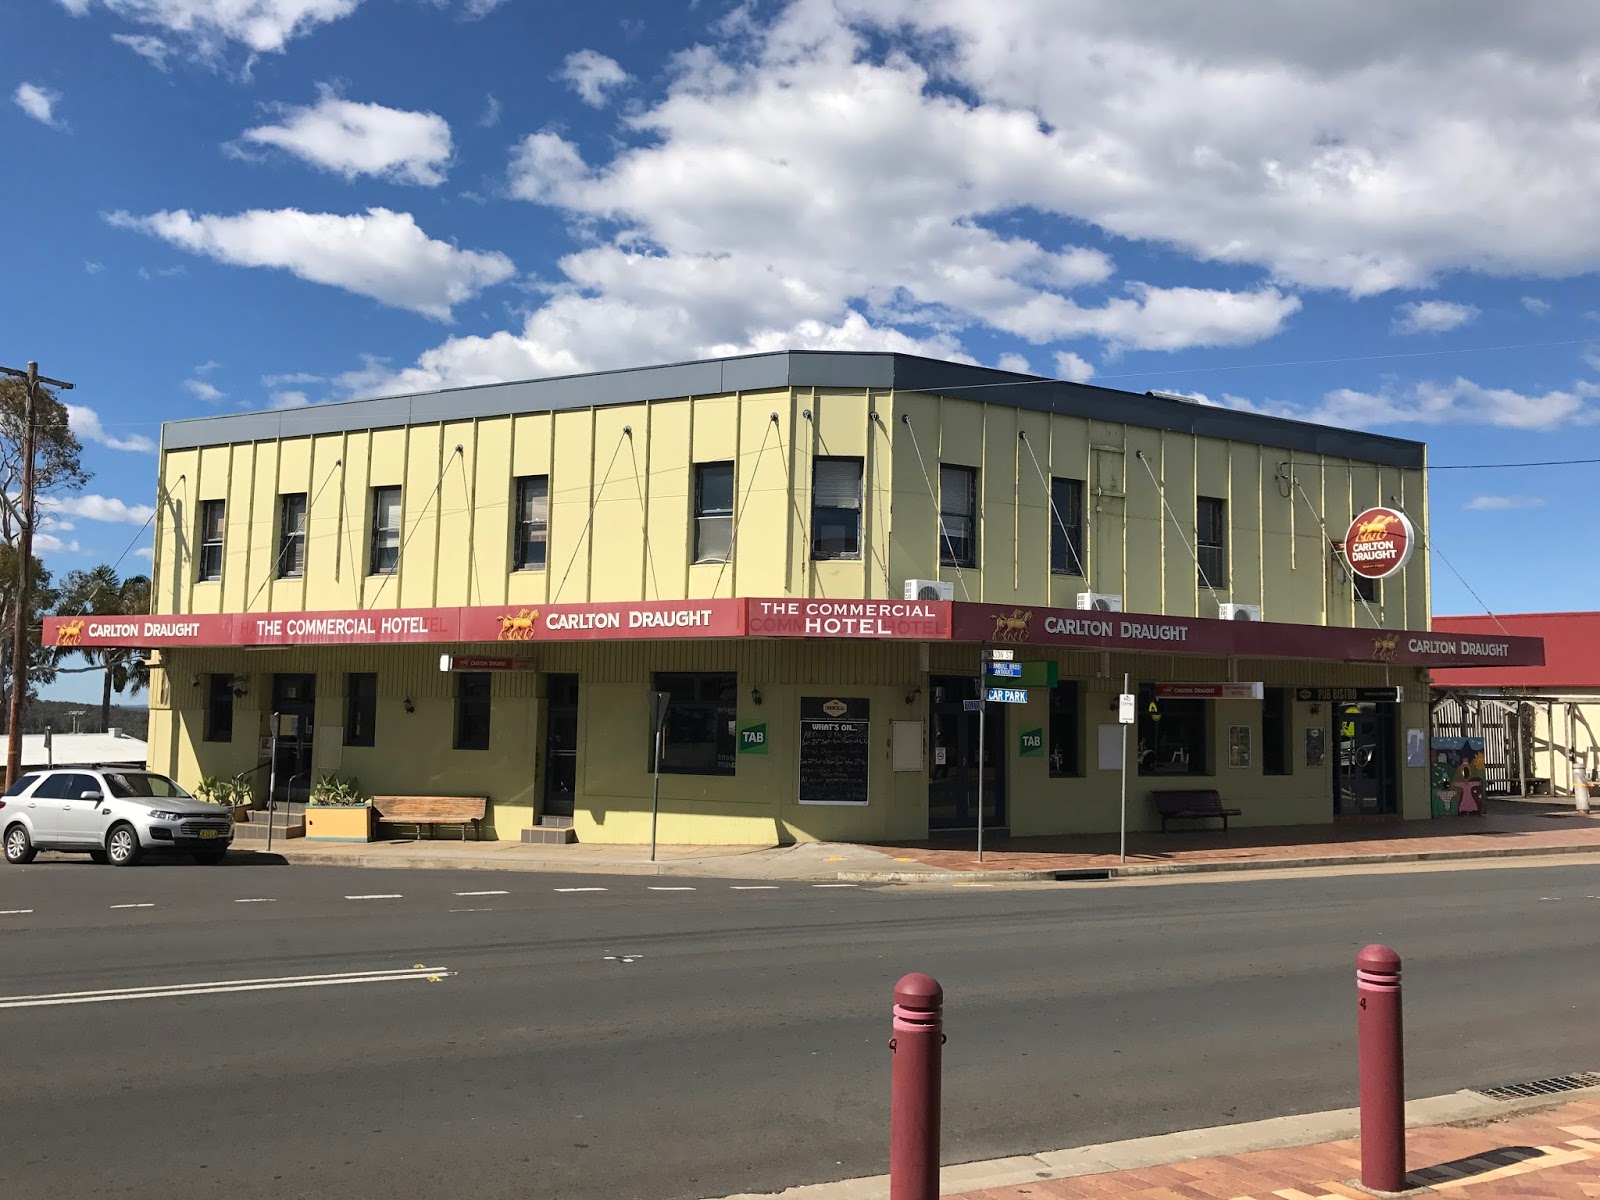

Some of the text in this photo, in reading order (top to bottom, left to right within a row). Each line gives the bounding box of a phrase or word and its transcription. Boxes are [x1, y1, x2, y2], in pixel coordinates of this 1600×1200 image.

[1353, 540, 1394, 552] CARLTON
[1352, 549, 1397, 562] DRAUGHT
[760, 602, 936, 618] THE COMMERCIAL
[256, 619, 282, 636] THE
[286, 617, 376, 636] COMMERCIAL
[381, 616, 429, 635] HOTEL
[545, 609, 713, 630] CARLTON DRAUGHT
[805, 617, 892, 635] HOTEL
[88, 622, 200, 637] CARLTON DRAUGHT
[1044, 616, 1188, 641] CARLTON DRAUGHT
[1407, 637, 1509, 657] CARLTON DRAUGHT
[1006, 651, 1013, 659] ST
[988, 690, 1025, 702] CAR PARK
[1317, 688, 1331, 700] PUB
[1333, 688, 1357, 700] BISTRO
[812, 723, 839, 731] WHAT'S
[742, 731, 764, 743] TAB
[1022, 736, 1041, 747] TAB
